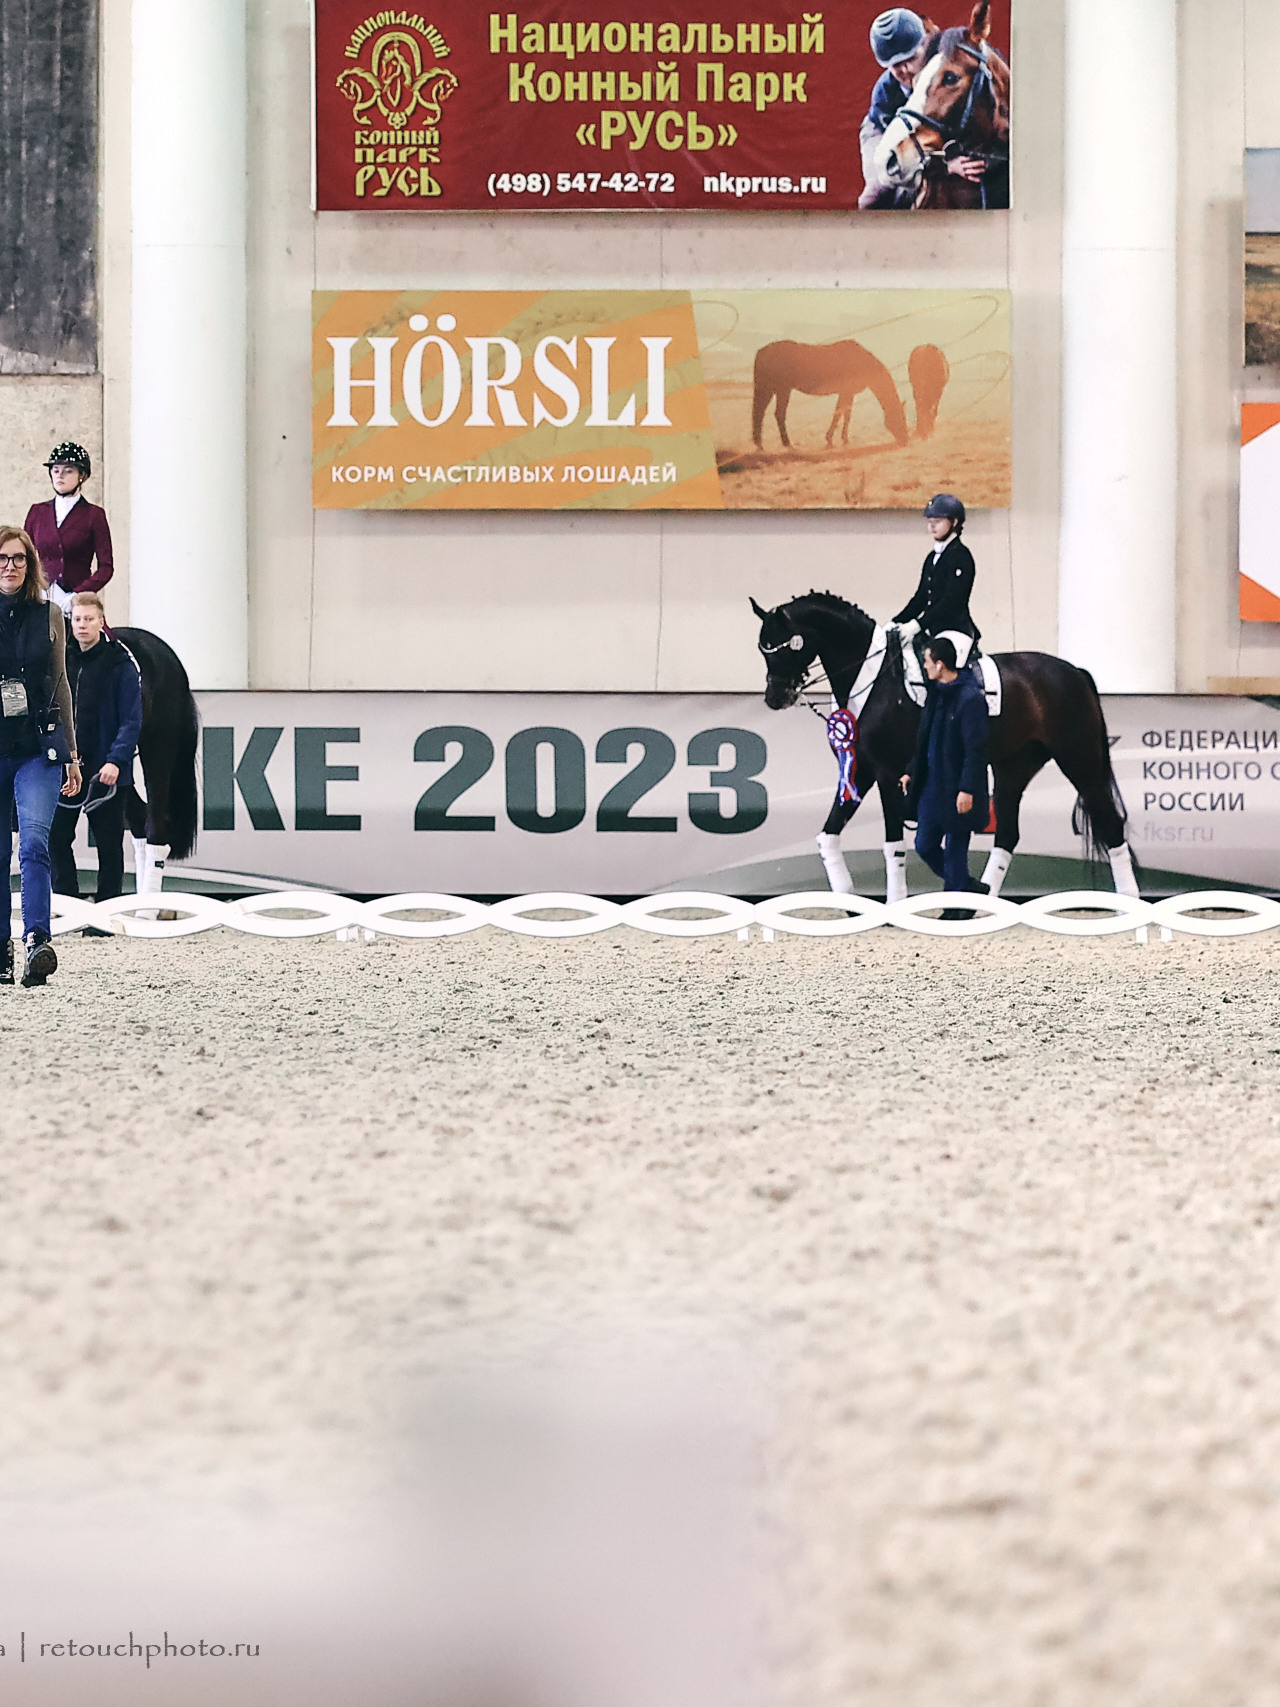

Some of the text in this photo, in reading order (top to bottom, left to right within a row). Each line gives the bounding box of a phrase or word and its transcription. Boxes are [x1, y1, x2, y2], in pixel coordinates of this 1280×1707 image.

[489, 12, 825, 60] Национальный
[508, 61, 808, 112] Конный Парк
[575, 110, 738, 151] «РУСЬ»
[354, 146, 441, 164] ПАРК
[355, 164, 442, 197] РУСЬ
[487, 172, 827, 197] (498) 547-42-72 nkprus.ru
[325, 313, 673, 430] HÖRSLI
[331, 462, 677, 485] КОРМ СЧАСТЛИВЫХ ЛОШАДЕЙ
[1142, 730, 1278, 752] ФЕДЕРАЦИ
[412, 724, 769, 834] 2023
[1142, 760, 1262, 781] КОННОГО
[1144, 792, 1245, 811] РОССИИ
[1142, 820, 1214, 842] fksr.ru
